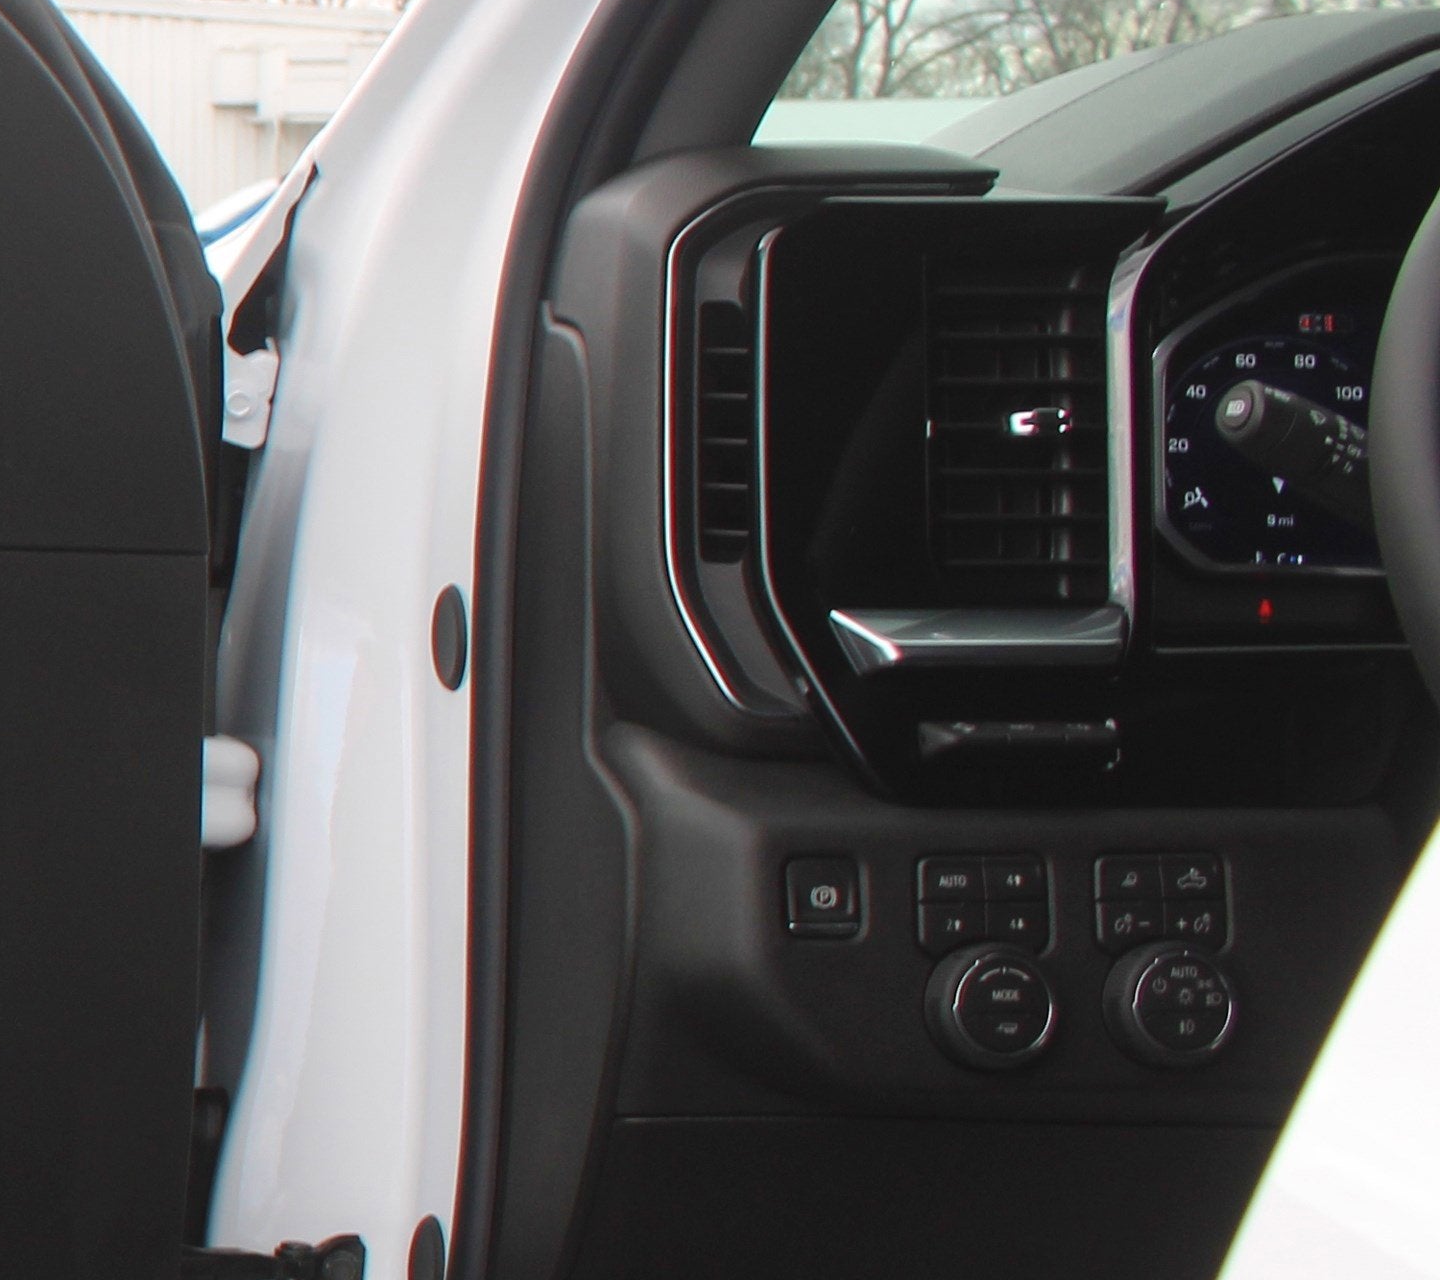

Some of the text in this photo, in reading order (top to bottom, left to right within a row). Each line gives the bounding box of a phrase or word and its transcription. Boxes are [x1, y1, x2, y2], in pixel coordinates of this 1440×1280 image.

[1236, 353, 1256, 368] 60
[1294, 353, 1316, 368] 80
[1185, 384, 1206, 399] 40
[1336, 386, 1363, 401] 100
[1168, 438, 1188, 453] 20
[938, 875, 967, 888] AUTO
[1170, 966, 1198, 979] AUTO
[991, 989, 1021, 1002] MODE
